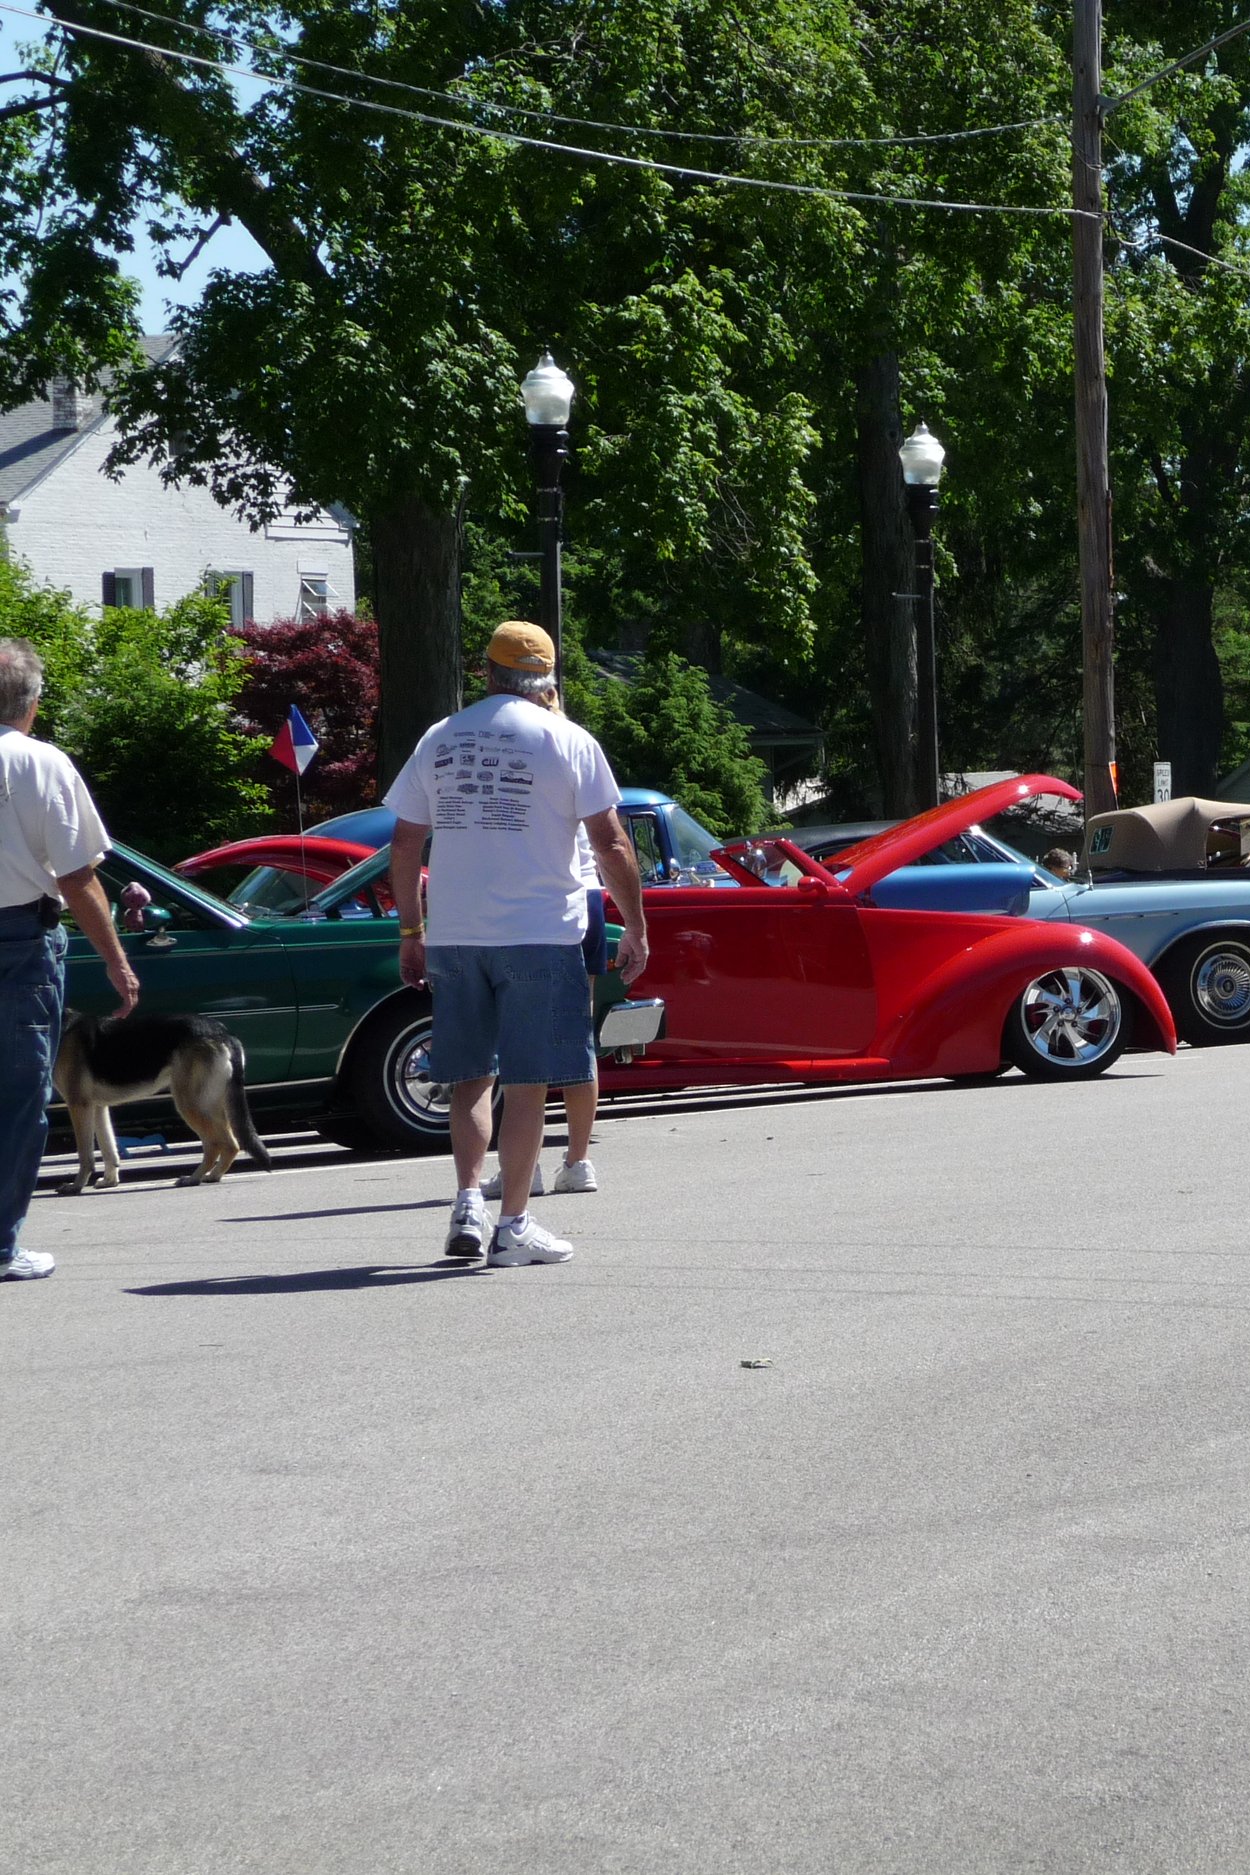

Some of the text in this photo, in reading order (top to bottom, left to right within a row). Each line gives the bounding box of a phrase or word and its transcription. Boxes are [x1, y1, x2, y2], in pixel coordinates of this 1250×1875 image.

[481, 758, 499, 767] CW
[1156, 769, 1169, 777] SPEED
[1157, 779, 1169, 787] LIMIT
[1157, 788, 1169, 802] 30
